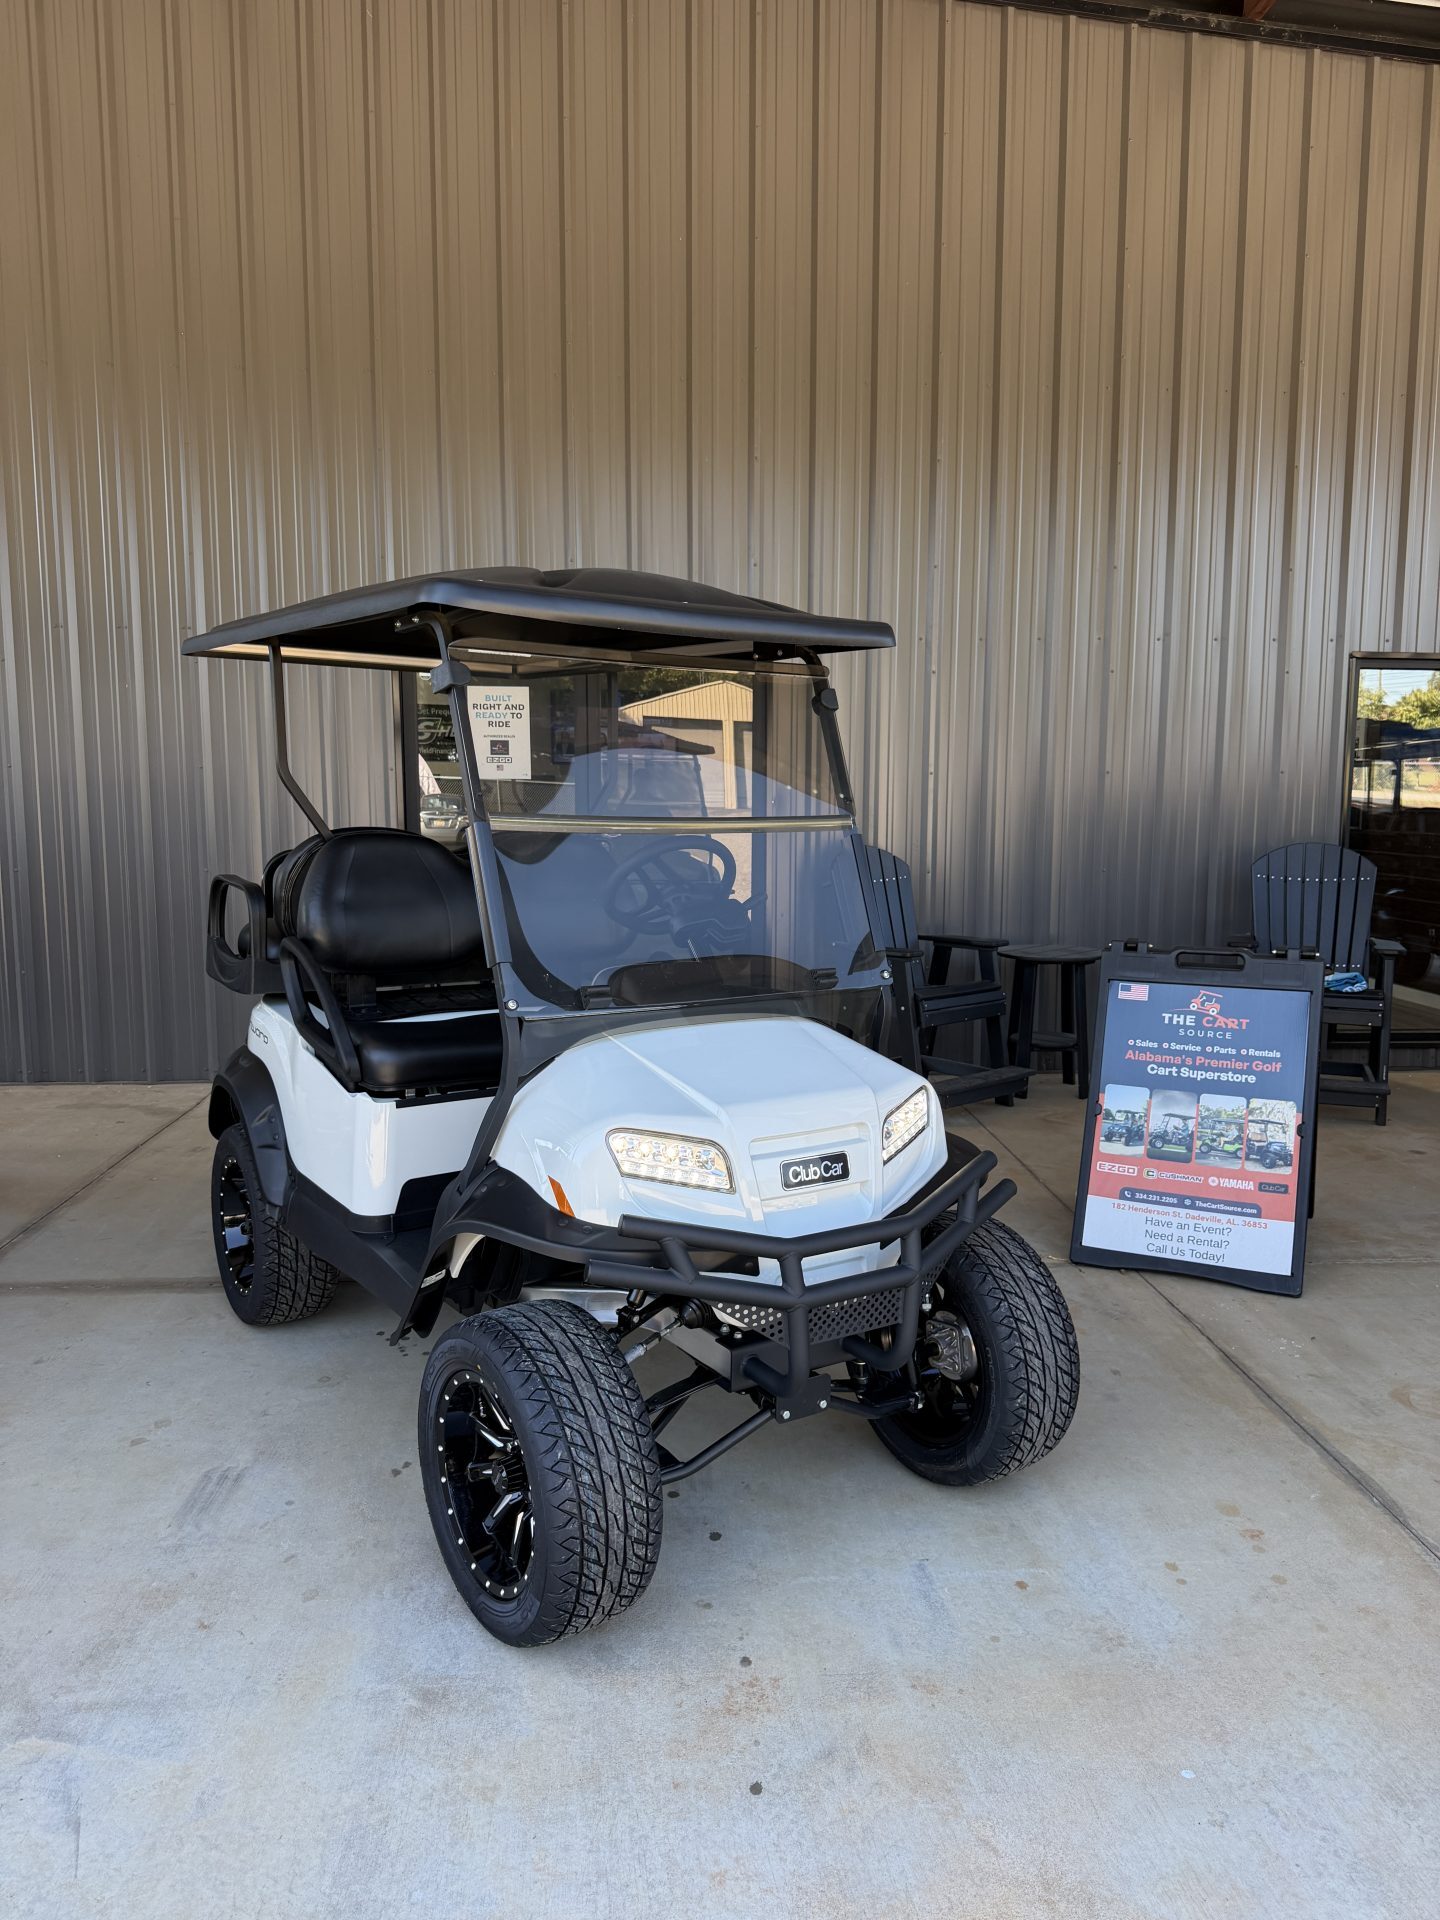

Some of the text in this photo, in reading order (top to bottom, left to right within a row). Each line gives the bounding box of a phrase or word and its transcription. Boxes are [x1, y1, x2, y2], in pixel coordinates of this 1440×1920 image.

[472, 703, 525, 711] RIGHT AND
[484, 694, 512, 702] BUILT
[475, 711, 508, 719] READY
[488, 720, 511, 728] RIDE
[1162, 1012, 1250, 1030] THE CART
[1178, 1028, 1233, 1040] SOURCE
[1135, 1039, 1281, 1058] Sales Service Parts Rentals
[1125, 1049, 1282, 1073] Alabama's Premier Golf
[1147, 1063, 1257, 1084] Cart Superstore
[1098, 1162, 1136, 1175] EZGO
[1219, 1177, 1254, 1191] YAMAHA
[1112, 1202, 1126, 1210] 182
[1128, 1204, 1170, 1217] Henderson
[1185, 1212, 1224, 1225] Dadeville,
[1242, 1220, 1268, 1229] 36853
[1195, 1200, 1257, 1214] TheCartSource.com
[1145, 1216, 1232, 1237] Have an Event?
[1144, 1229, 1230, 1250] Need a Rental?
[1146, 1242, 1225, 1263] Call Us Today!
